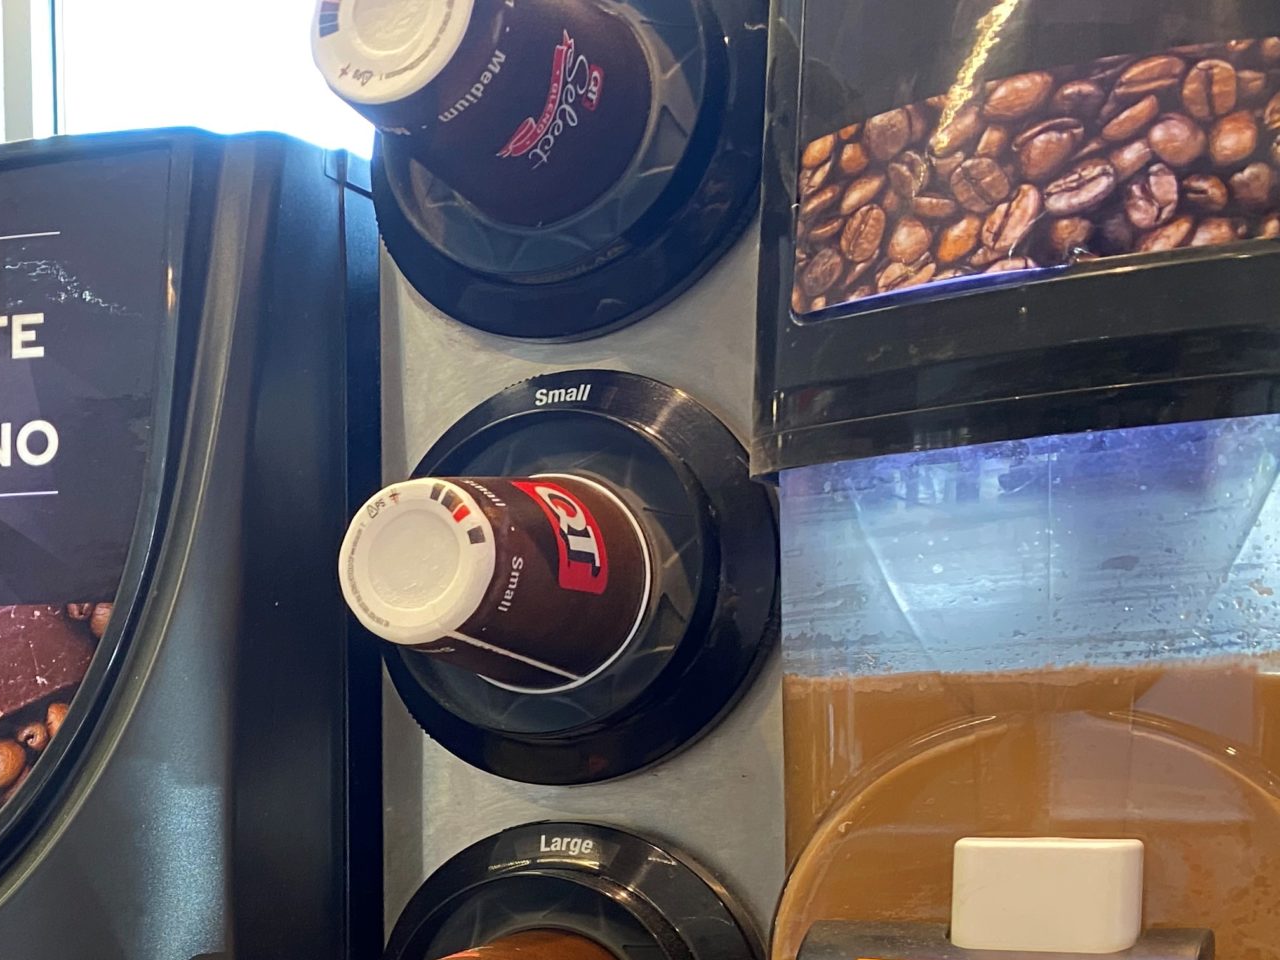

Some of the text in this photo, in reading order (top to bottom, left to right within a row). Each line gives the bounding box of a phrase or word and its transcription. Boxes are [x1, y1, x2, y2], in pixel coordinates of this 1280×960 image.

[439, 49, 506, 122] Medium
[528, 47, 589, 170] Select
[535, 384, 591, 407] Small
[498, 555, 525, 613] Small
[539, 834, 594, 854] Large
